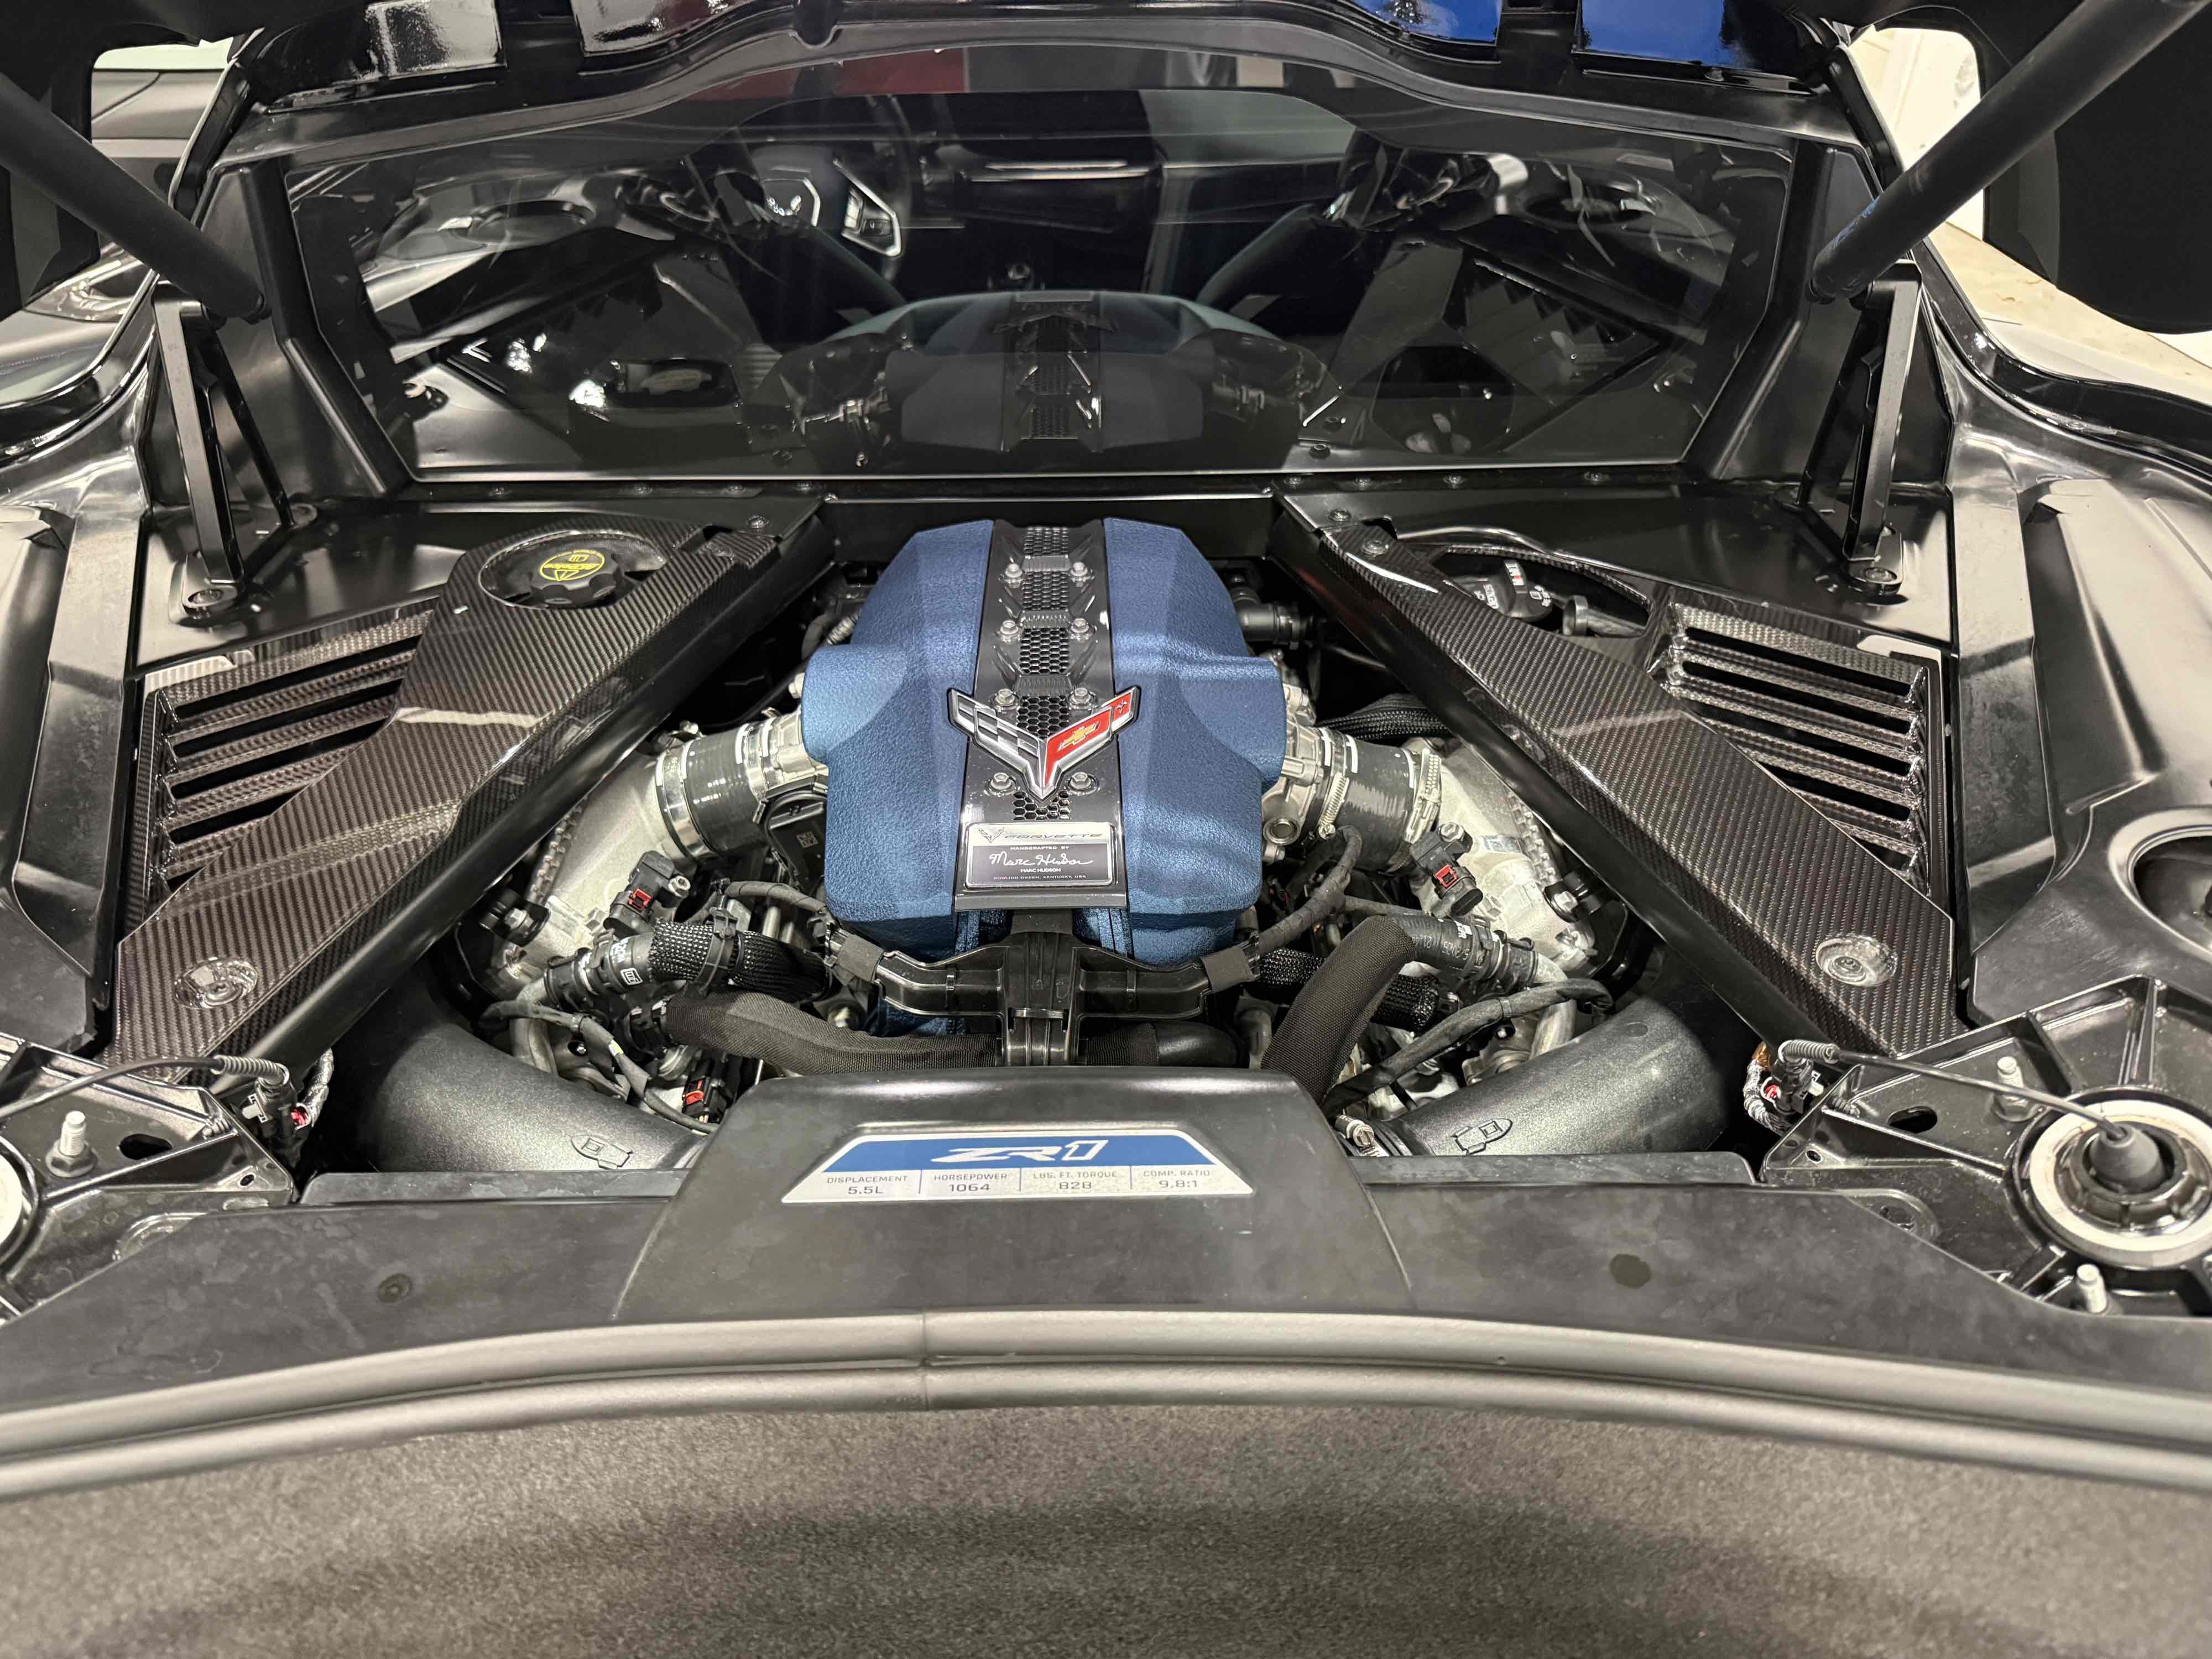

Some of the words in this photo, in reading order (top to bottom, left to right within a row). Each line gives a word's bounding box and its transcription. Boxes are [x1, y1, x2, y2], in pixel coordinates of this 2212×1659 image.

[931, 1139, 1109, 1162] ZR1
[827, 1175, 907, 1183] DISPLACEMENT
[933, 1173, 1009, 1181] HORSEPOWER
[950, 1183, 991, 1192] 1064
[1059, 1181, 1093, 1190] 828
[1159, 1179, 1198, 1188] 9.8:1
[848, 1186, 884, 1194] 5.5L
